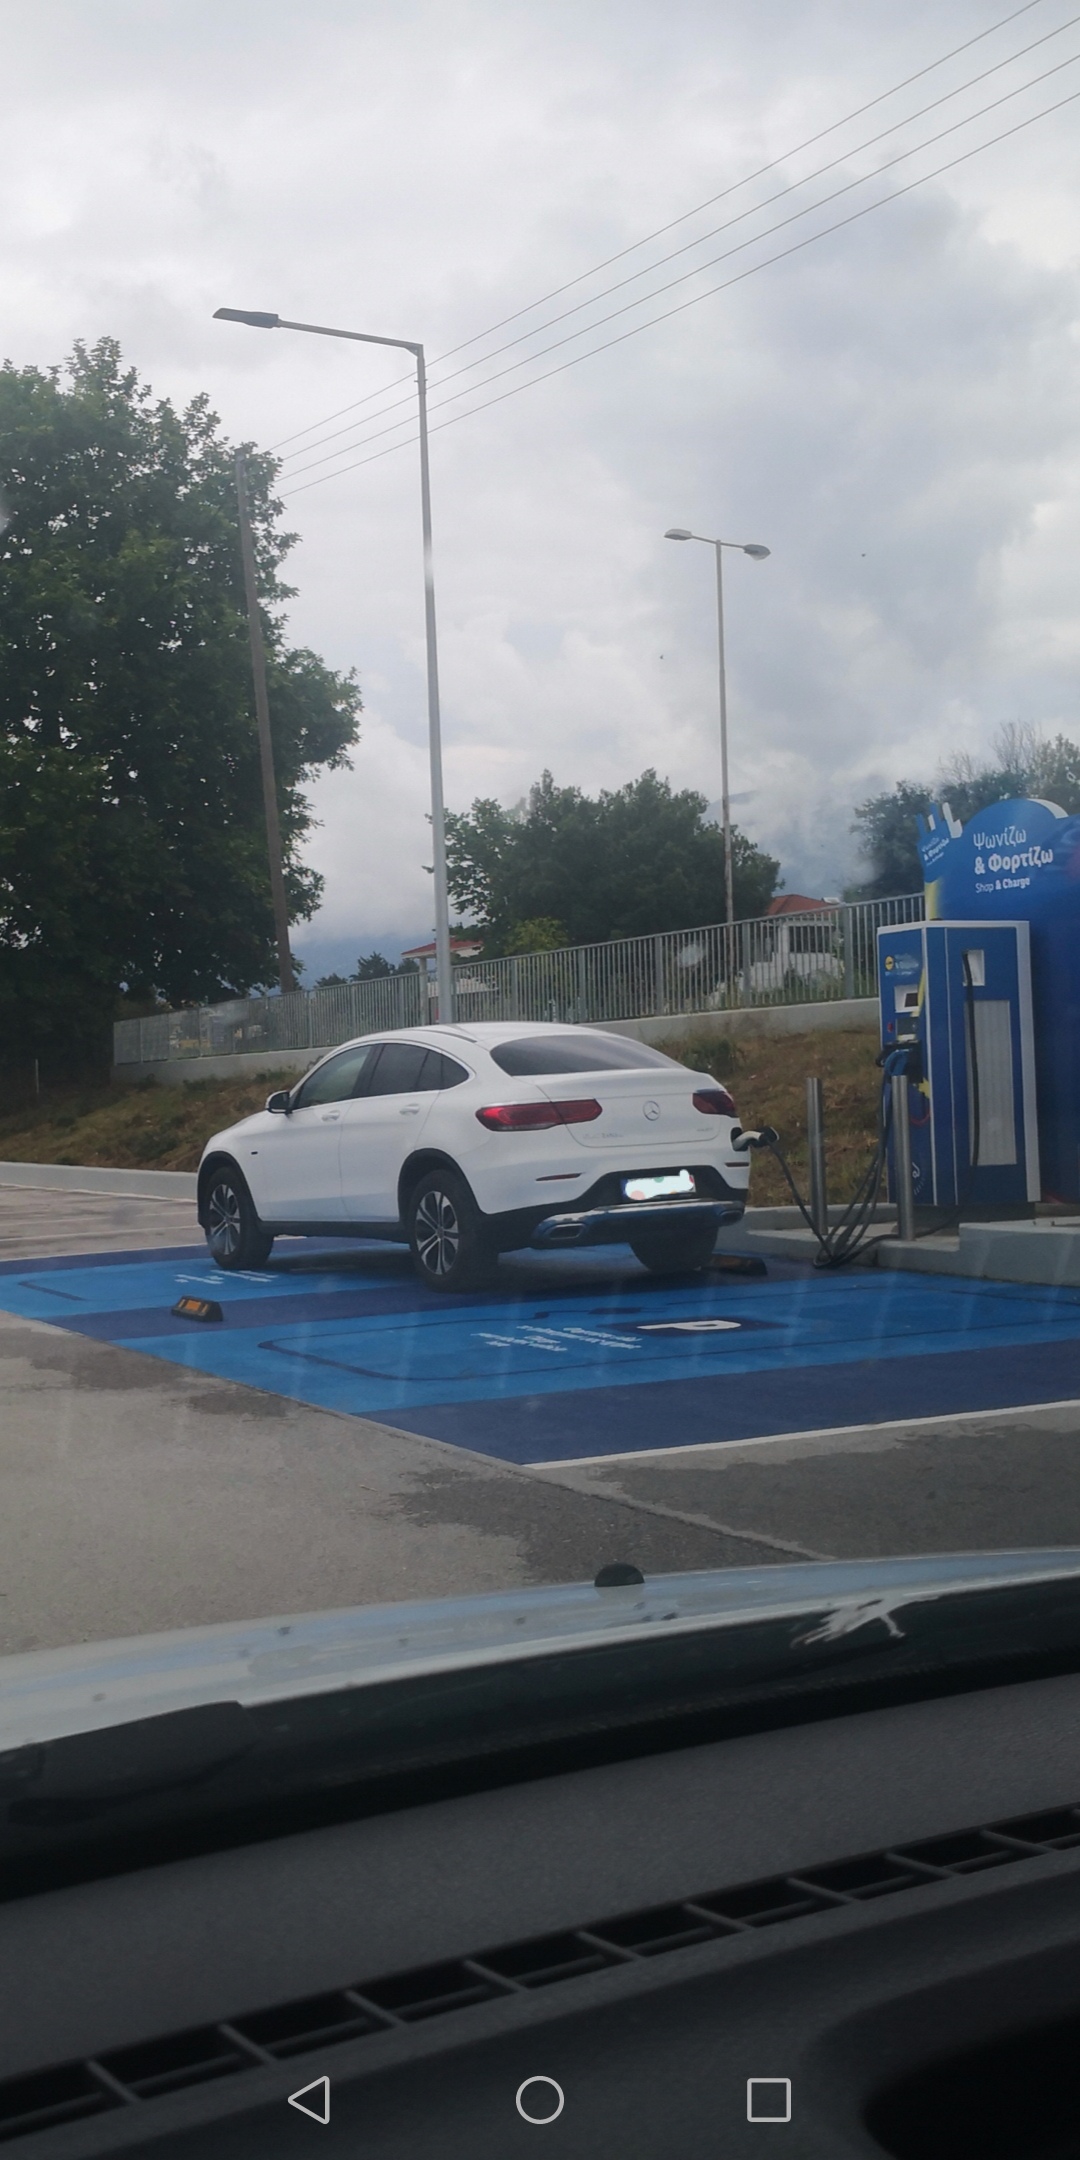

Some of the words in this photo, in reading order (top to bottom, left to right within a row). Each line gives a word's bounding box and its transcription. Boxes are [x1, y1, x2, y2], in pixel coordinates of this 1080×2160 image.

[973, 825, 1027, 850] Ψωνίζω
[974, 856, 985, 875] &
[988, 846, 1054, 874] Φορτίζω
[975, 883, 994, 893] Shop
[1002, 878, 1030, 889] Charge
